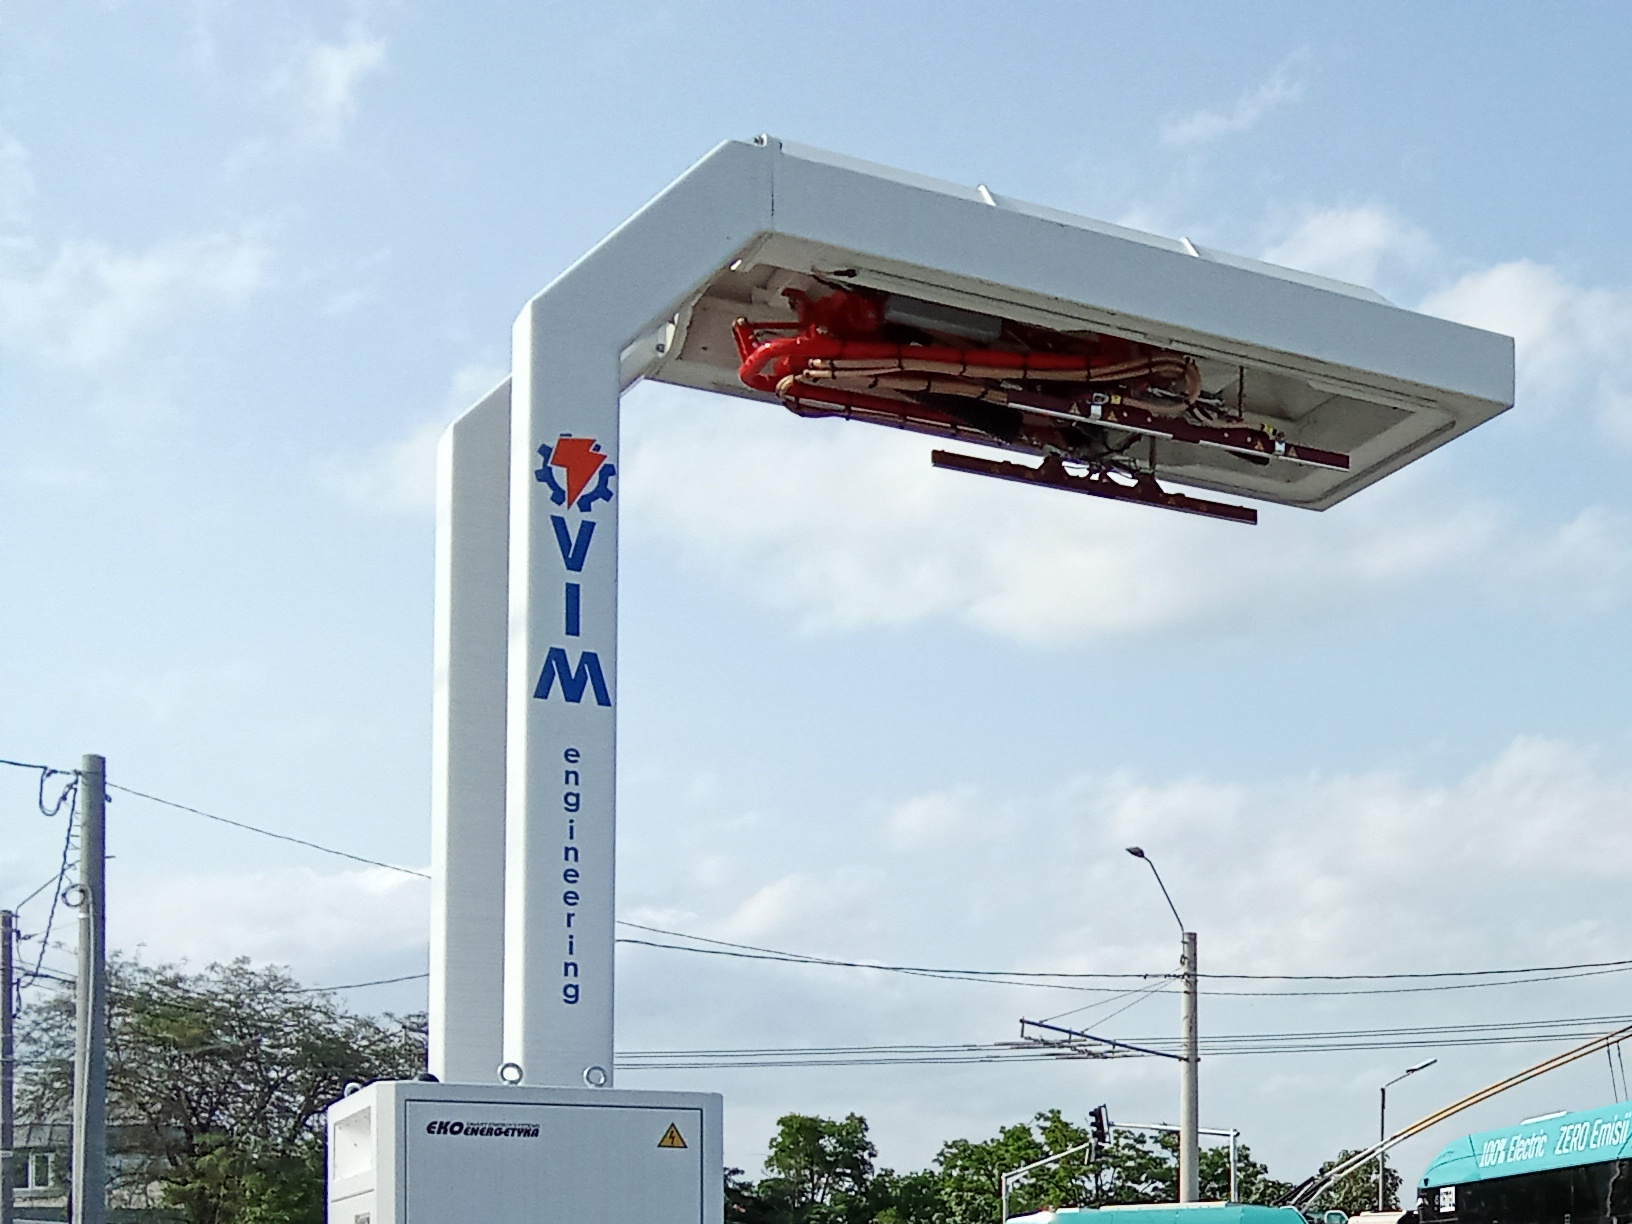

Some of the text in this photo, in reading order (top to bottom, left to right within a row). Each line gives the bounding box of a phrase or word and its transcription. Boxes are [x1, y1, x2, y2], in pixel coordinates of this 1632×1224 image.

[533, 514, 612, 707] VIM
[563, 747, 580, 1004] engineering
[1479, 1111, 1632, 1168] 100% Electric ZERO Emisii
